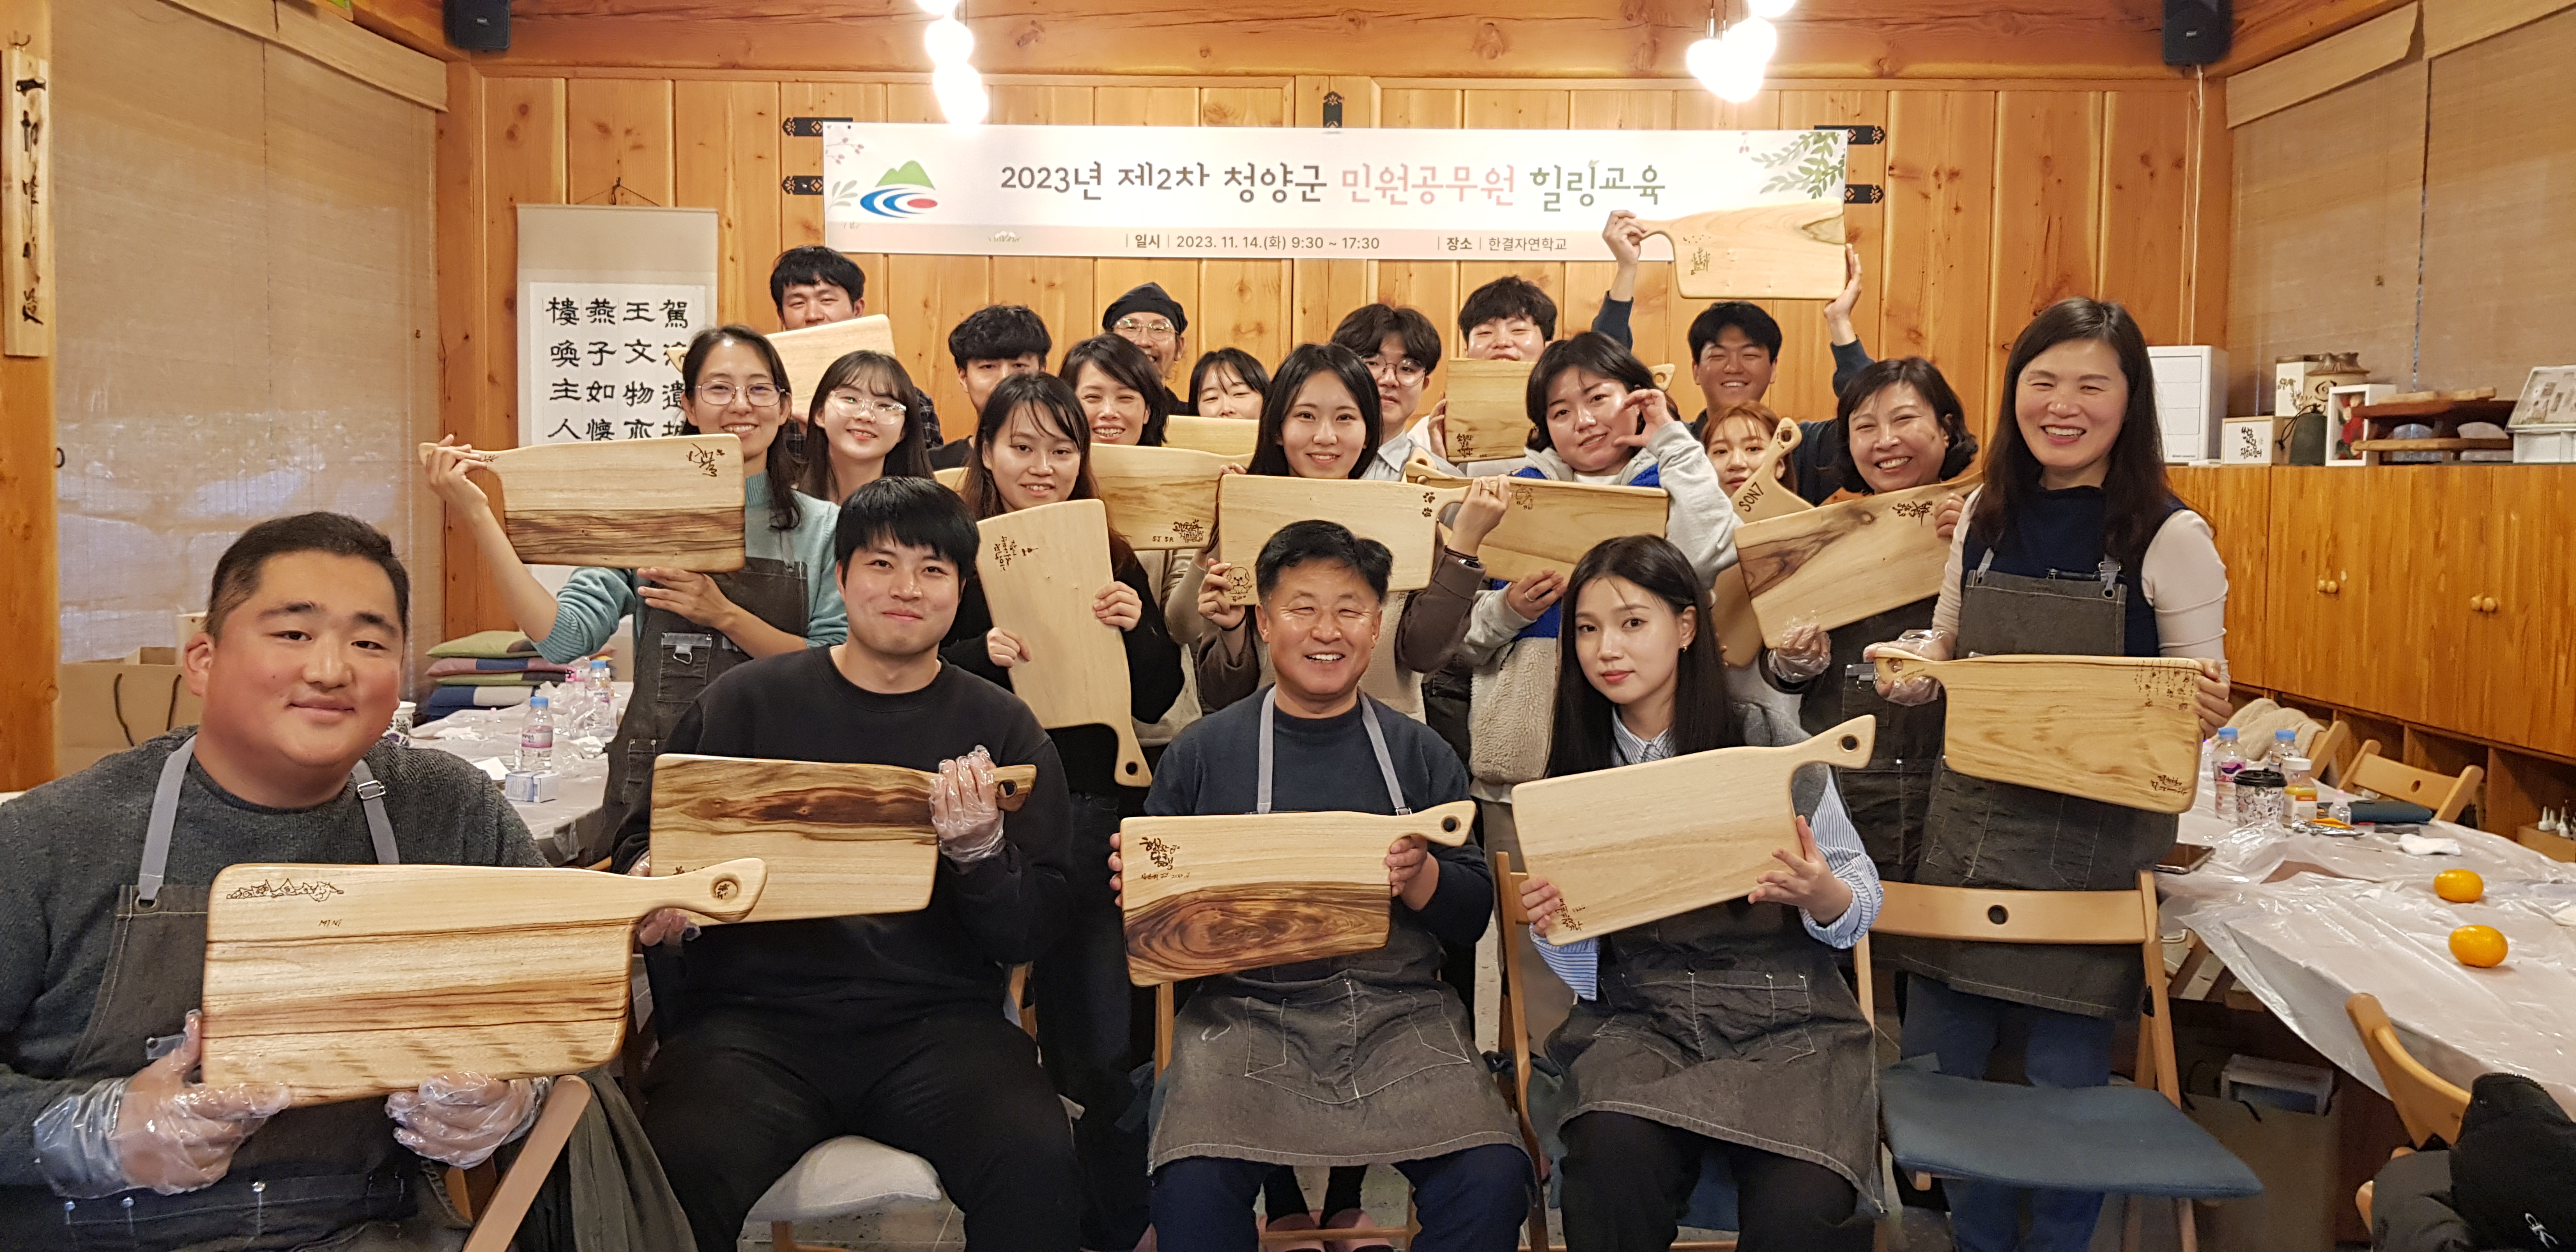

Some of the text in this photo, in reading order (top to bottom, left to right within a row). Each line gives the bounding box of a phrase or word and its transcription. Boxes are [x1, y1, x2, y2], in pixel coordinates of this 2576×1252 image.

[1000, 160, 1666, 212] 2023년 제2차 청양군 민원공무원 힐링교육
[1135, 234, 1160, 248] 일시
[1177, 236, 1216, 248] 2023.
[1222, 237, 1238, 248] 11.
[1243, 235, 1286, 250] 14.(화)
[1291, 237, 1324, 249] 9:30
[1342, 237, 1380, 249] 17:30
[1446, 236, 1567, 252] 장소 한결자연학교
